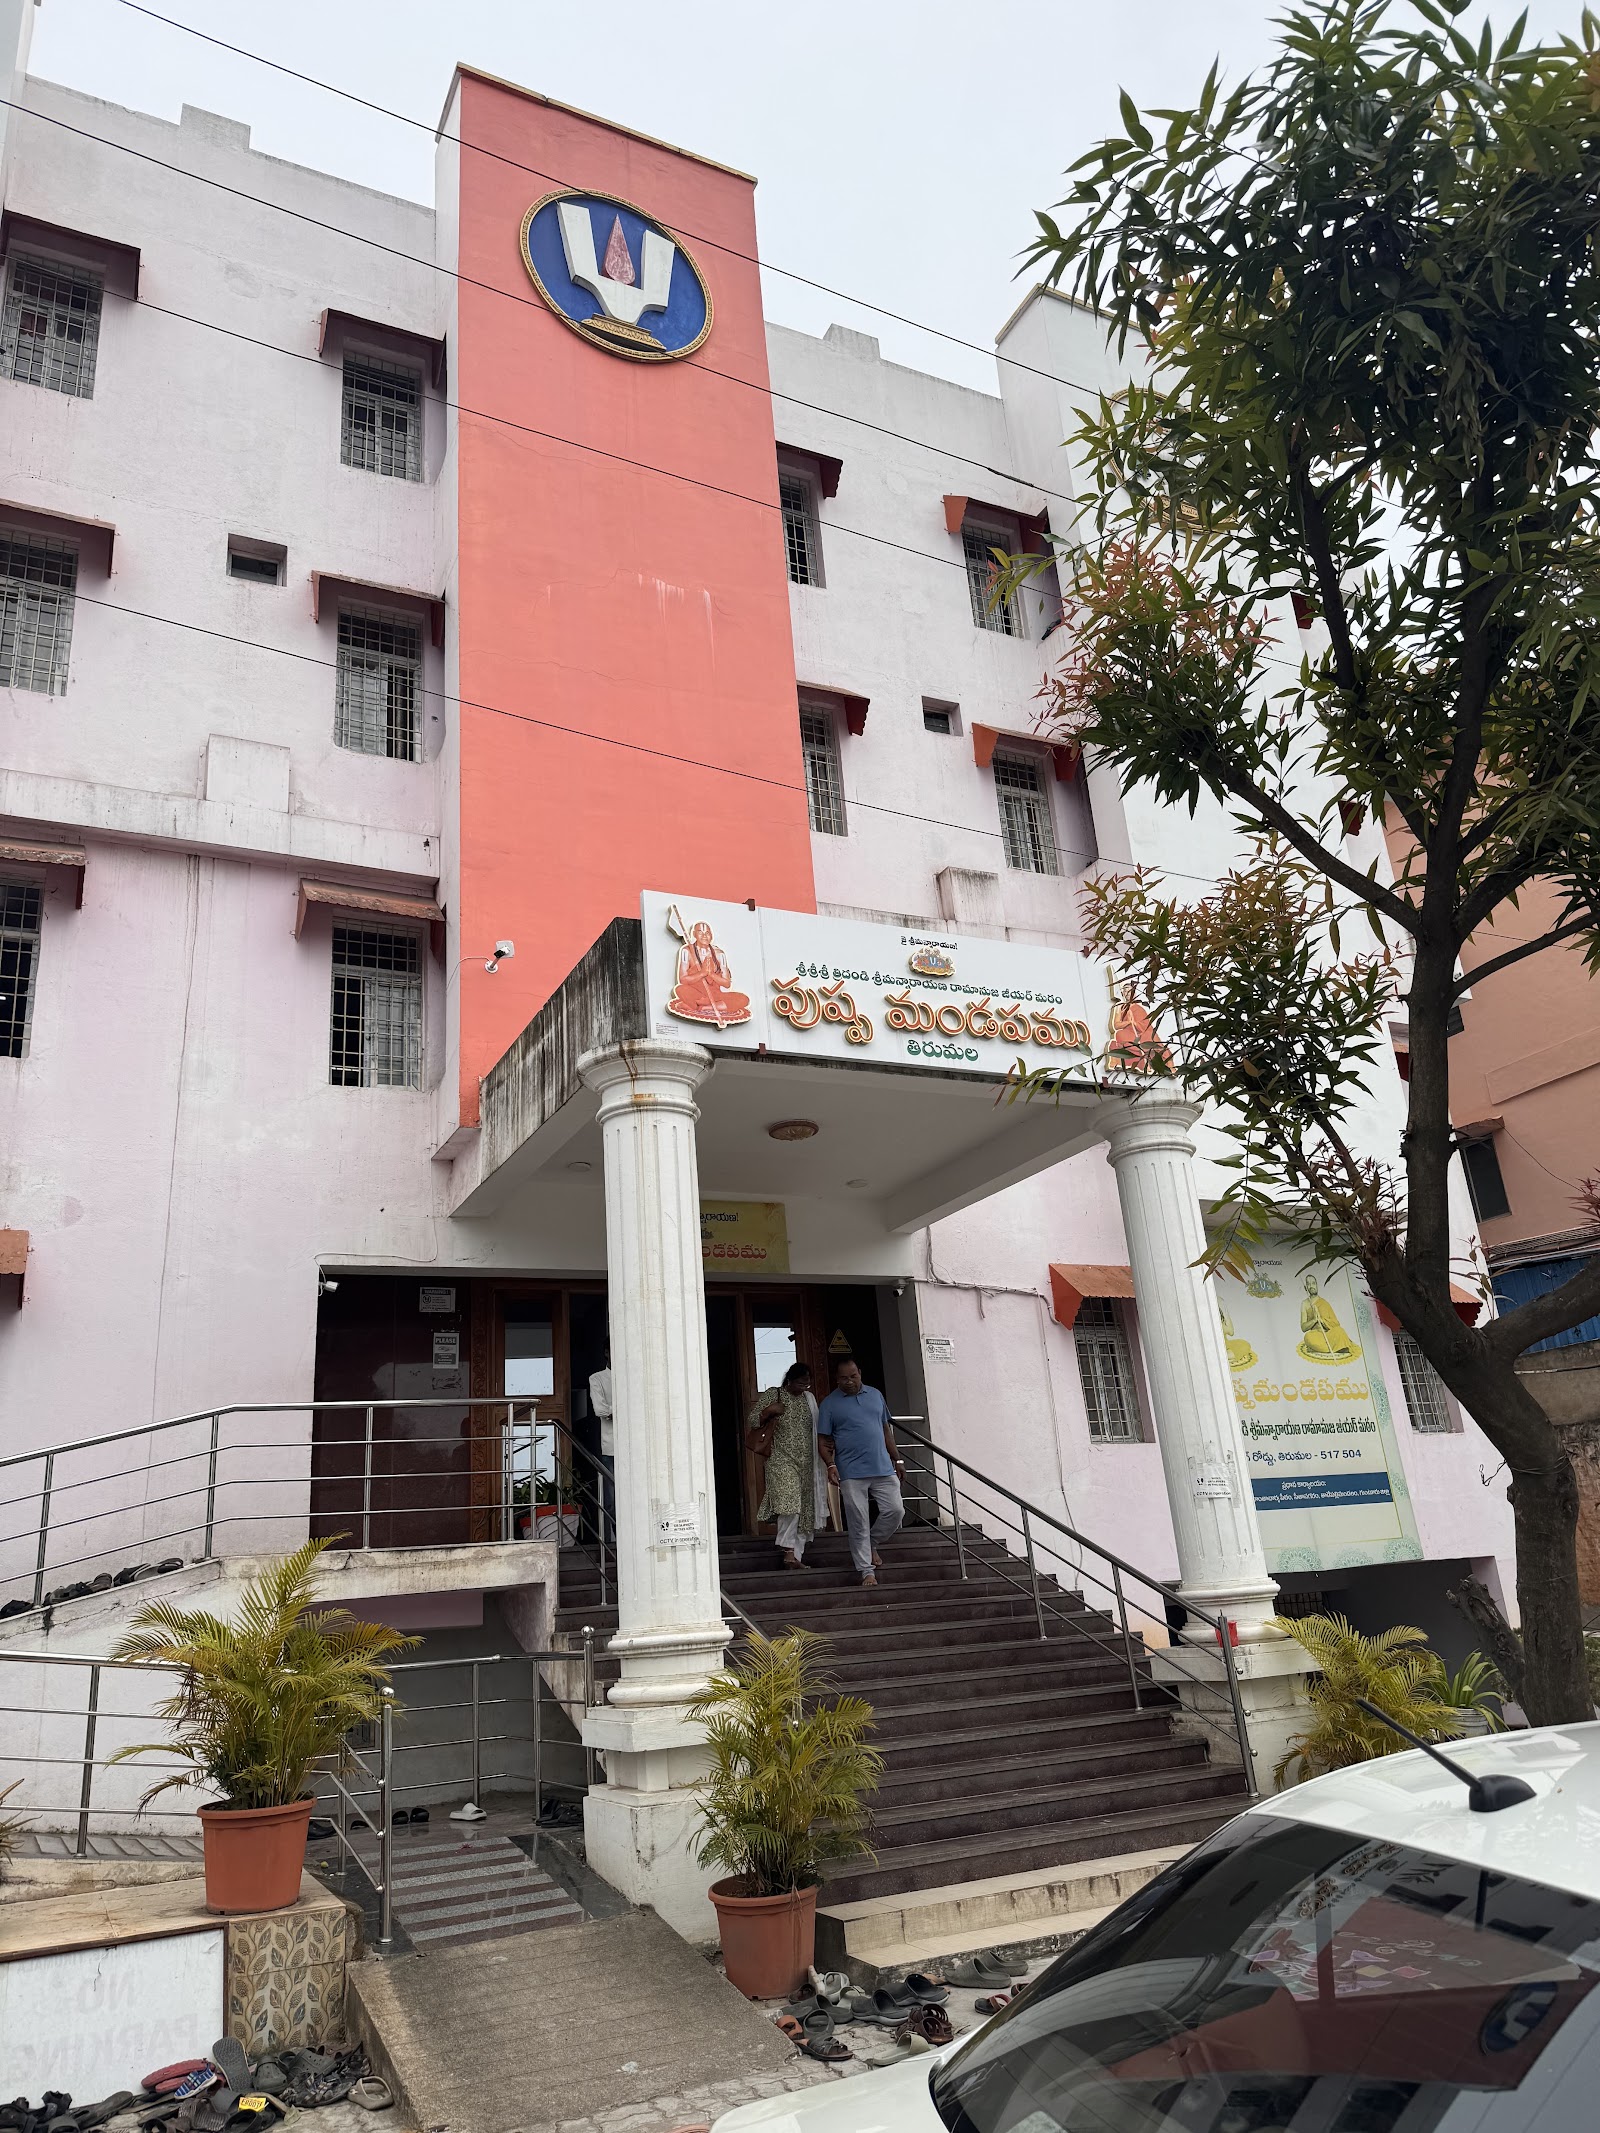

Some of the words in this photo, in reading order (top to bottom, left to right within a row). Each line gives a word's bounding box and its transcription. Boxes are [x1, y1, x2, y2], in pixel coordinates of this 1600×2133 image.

[872, 970, 948, 990] శ్రీమన్నారాయణ
[770, 975, 875, 1046] పుష్ప
[884, 989, 1093, 1051] మండపము
[906, 1037, 980, 1062] తిరుమల
[1278, 1451, 1312, 1462] తిరుమల
[1320, 1450, 1340, 1460] 517
[1342, 1449, 1362, 1459] 504
